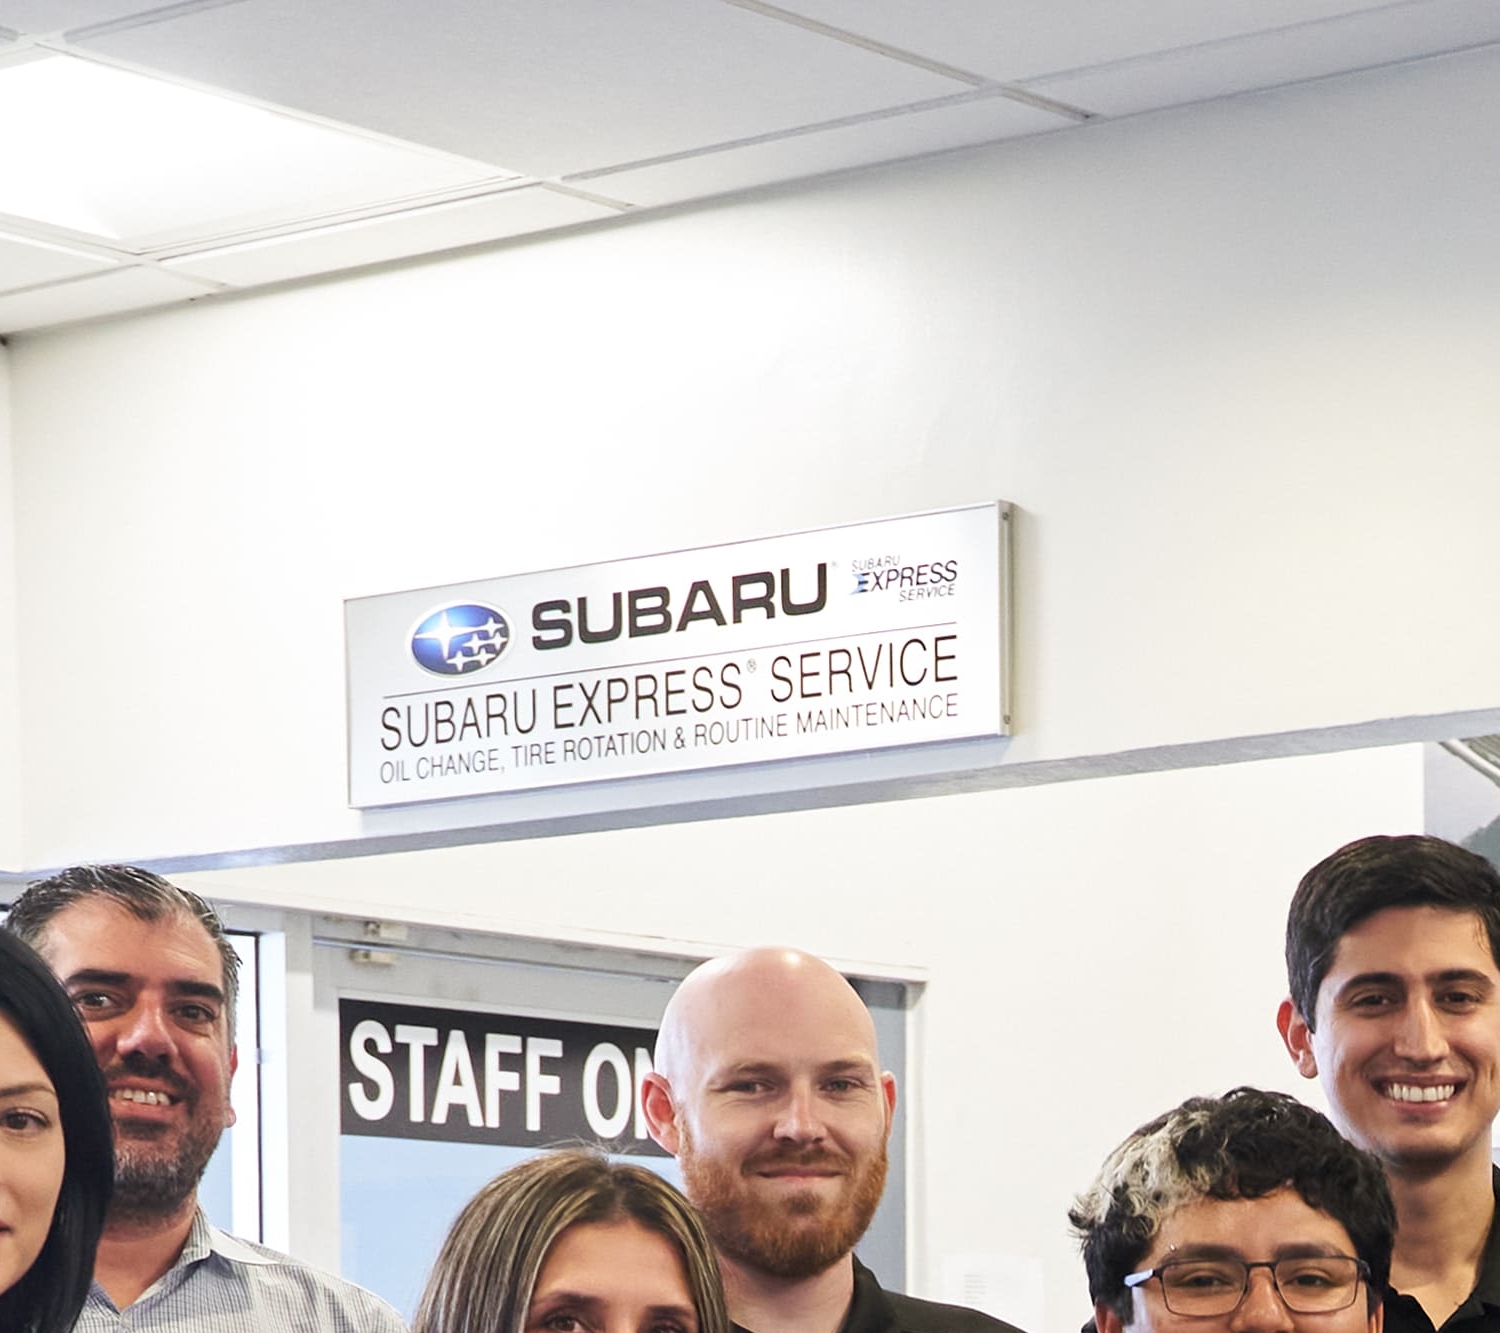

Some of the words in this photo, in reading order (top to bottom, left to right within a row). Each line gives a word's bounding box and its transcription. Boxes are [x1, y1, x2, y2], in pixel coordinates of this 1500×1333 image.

[531, 563, 828, 651] SUBARU
[852, 555, 900, 572] SUBARU
[852, 560, 958, 593] EXPRESS
[899, 584, 956, 602] SERVICE
[381, 688, 536, 751] SUBARU
[770, 635, 958, 703] SERVICE
[379, 759, 410, 784] OIL
[416, 748, 506, 779] CHANGE,
[511, 741, 557, 769] TIRE
[563, 728, 667, 762] ROTATION
[673, 726, 686, 750] &
[694, 713, 788, 747] ROUTINE
[796, 692, 959, 735] MAINTENANCE
[348, 1018, 564, 1132] STAFF
